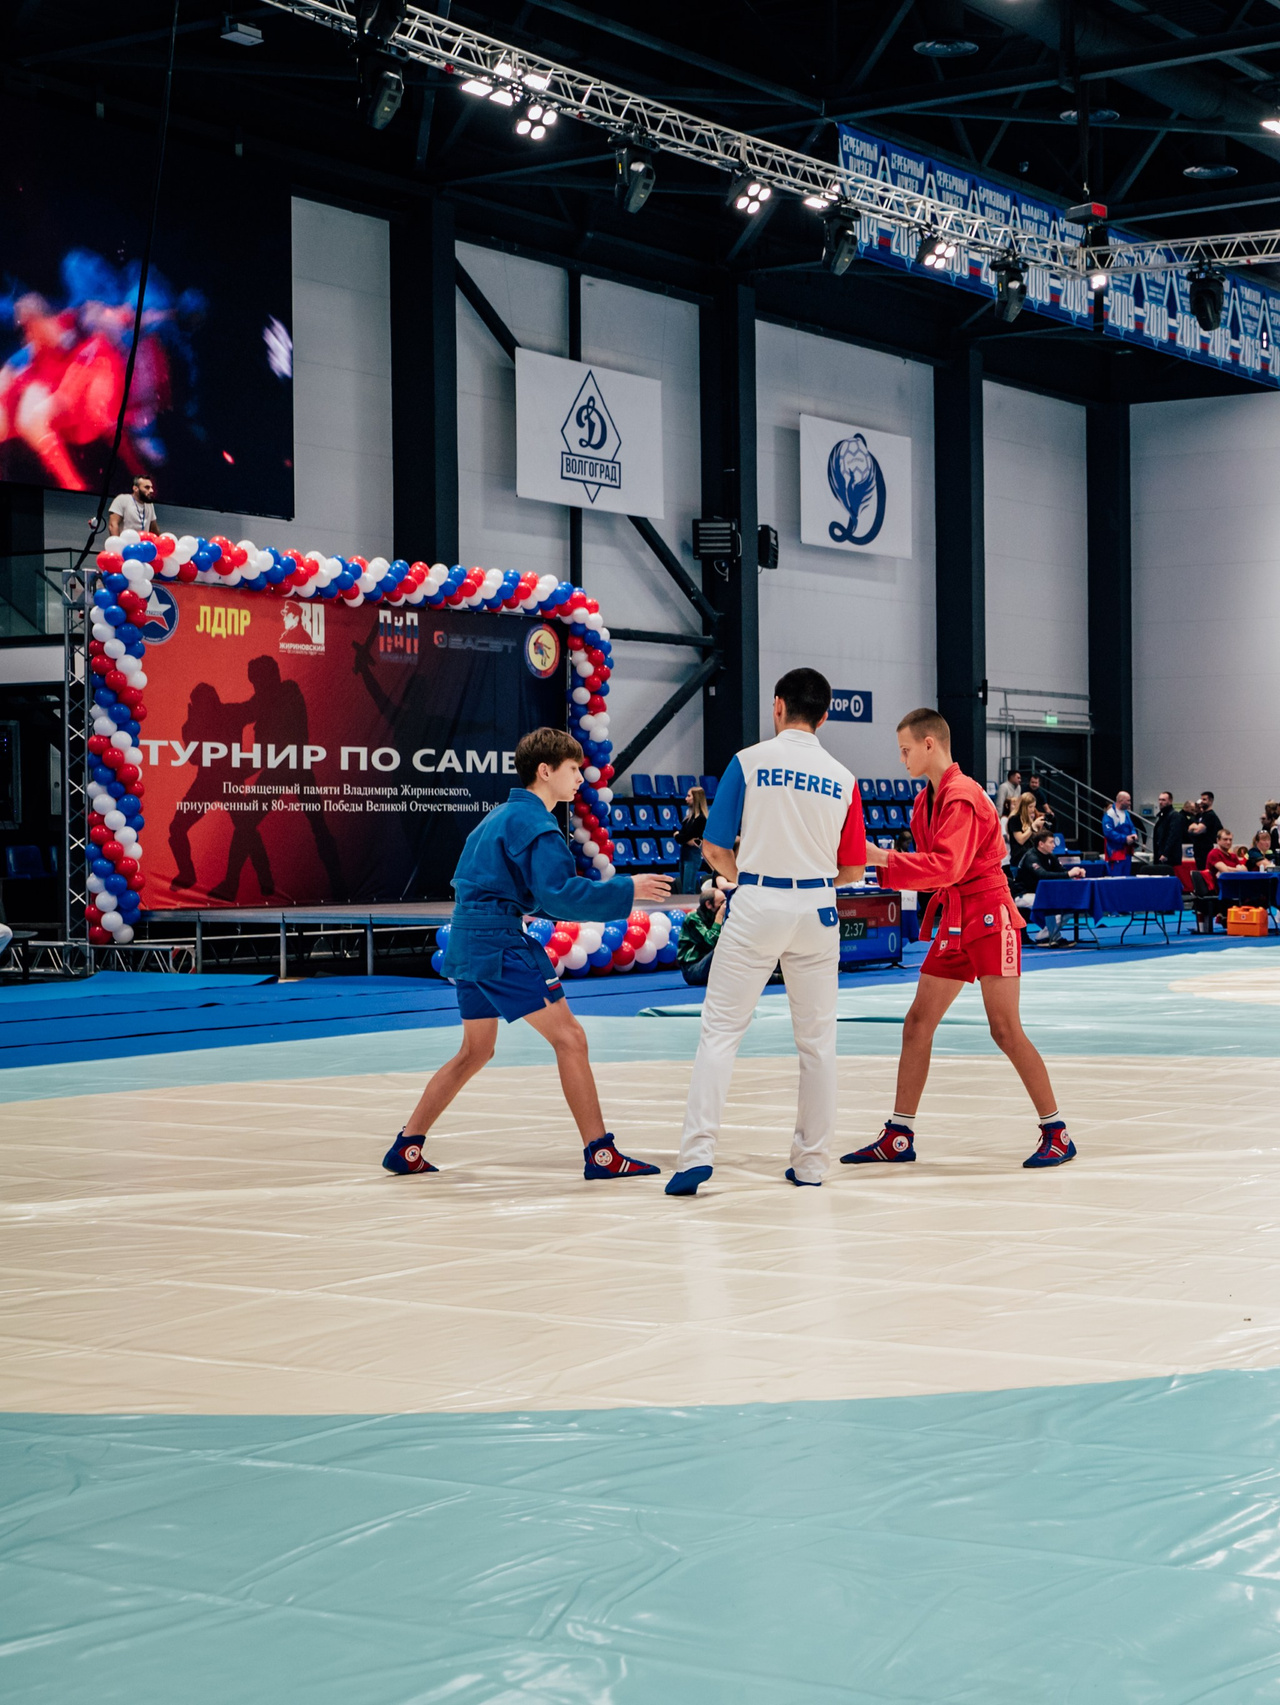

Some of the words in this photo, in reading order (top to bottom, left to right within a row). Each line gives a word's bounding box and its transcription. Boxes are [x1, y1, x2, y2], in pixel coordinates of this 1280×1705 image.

[1108, 289, 1135, 331] 2009
[1143, 301, 1168, 343] 2010
[1176, 312, 1200, 351] 2011
[1208, 327, 1232, 362] 2012
[1239, 333, 1261, 372] 2013
[565, 457, 617, 483] ВОЛГОГРАД
[195, 605, 251, 639] ЛДПР
[828, 698, 849, 711] ТОР
[139, 739, 327, 770] ТУРНИР
[340, 745, 401, 772] ПО
[412, 748, 518, 775] САМБ
[222, 781, 300, 796] Посвященный
[303, 785, 340, 796] памяти
[343, 783, 398, 798] Владимира
[400, 784, 472, 798] Жириновского,
[756, 768, 843, 800] REFEREE
[176, 799, 259, 814] приуроченный
[262, 801, 269, 812] к
[271, 799, 321, 812] 80-летию
[324, 800, 363, 813] Победы
[366, 800, 407, 812] Великой
[409, 801, 480, 812] Отечественной
[888, 902, 896, 923] 0
[844, 923, 864, 937] 2:37
[888, 932, 897, 953] 0
[1005, 924, 1014, 964] САМБО
